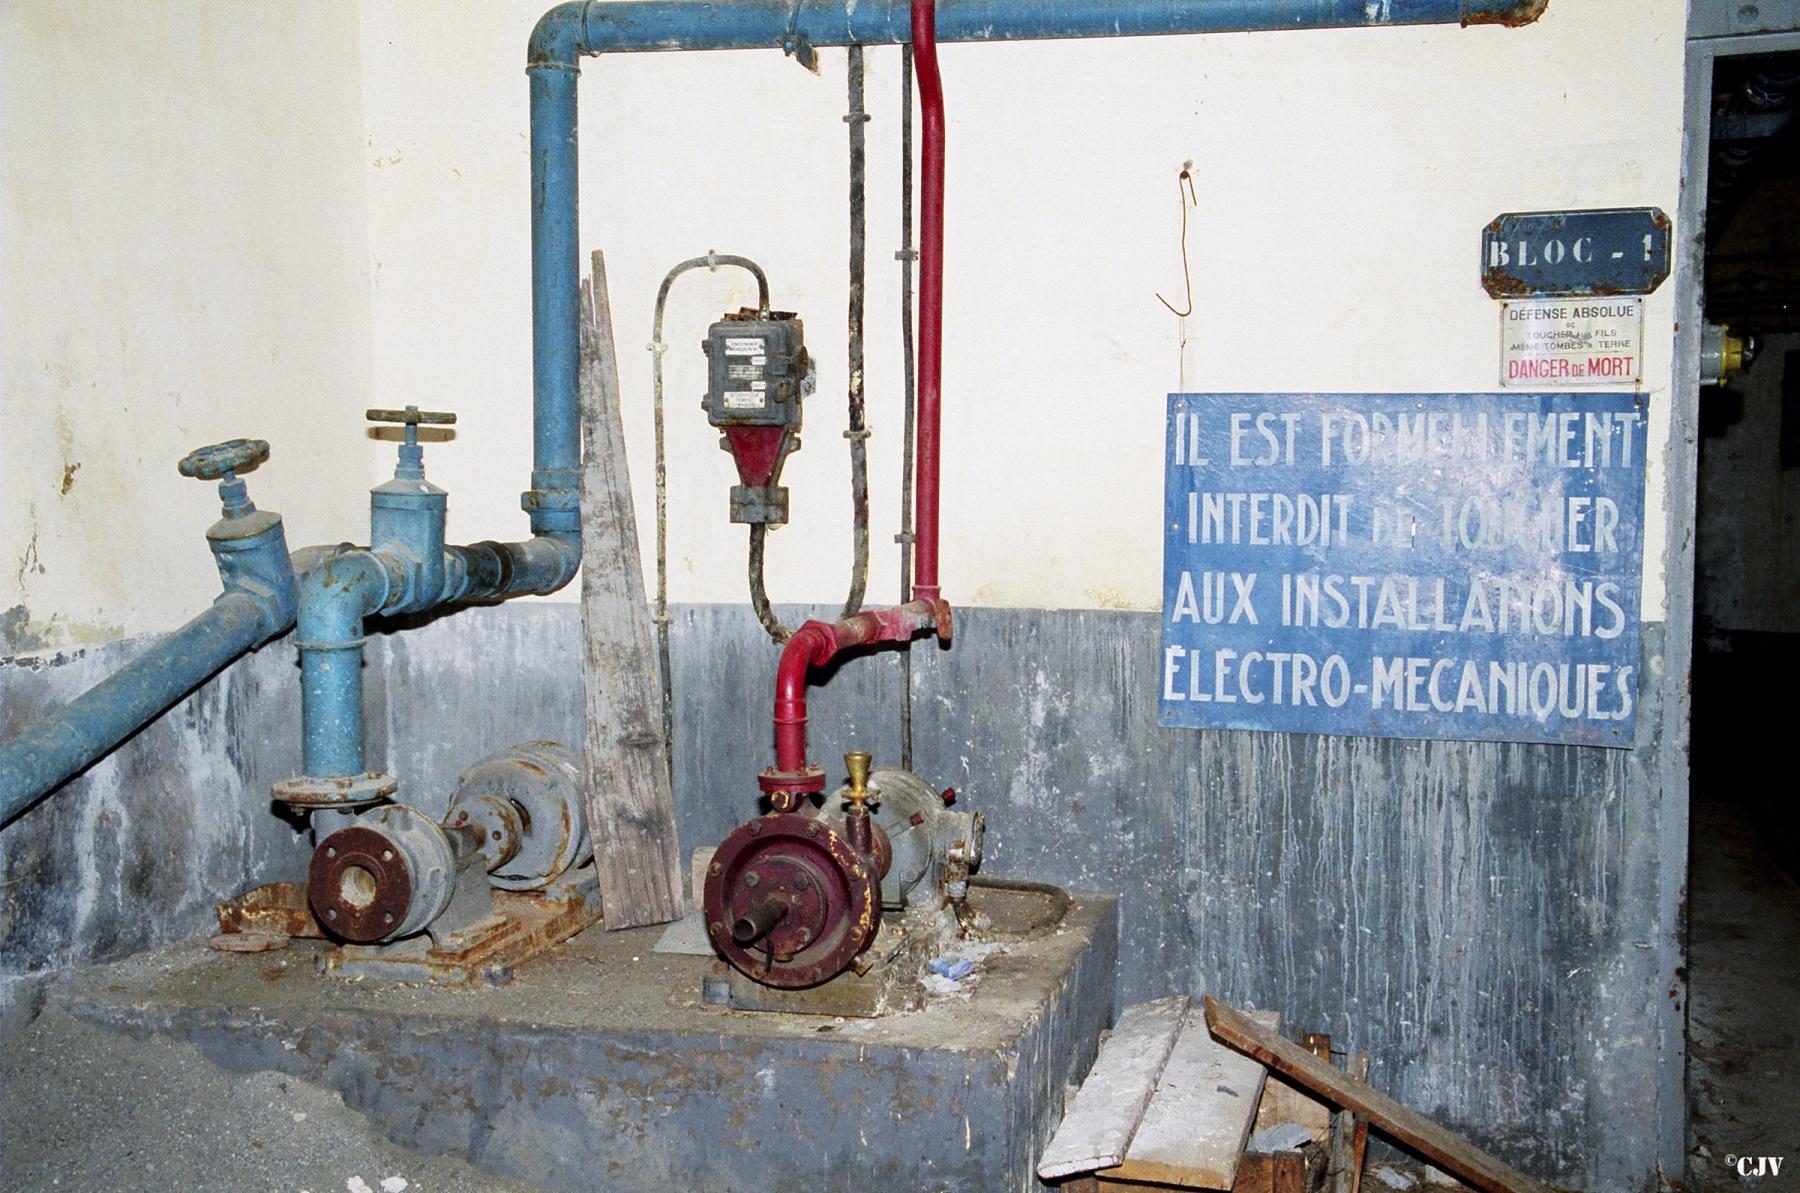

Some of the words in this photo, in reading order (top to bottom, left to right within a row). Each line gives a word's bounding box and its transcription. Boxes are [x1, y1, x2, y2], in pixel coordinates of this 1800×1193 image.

[1490, 238, 1592, 267] BLOC
[1643, 234, 1652, 262] 1
[1572, 305, 1634, 319] ABSOLUE
[1595, 329, 1617, 337] FILS
[1598, 339, 1631, 349] TERRE
[1509, 359, 1569, 379] DANGER
[1571, 364, 1585, 377] DE
[1588, 356, 1634, 377] MORT
[1175, 412, 1210, 466] IL
[1230, 412, 1301, 466] EST
[1188, 492, 1354, 546] INTERDIT
[1172, 571, 1259, 625] AUX
[1282, 574, 1626, 639] INSTALLATIONS
